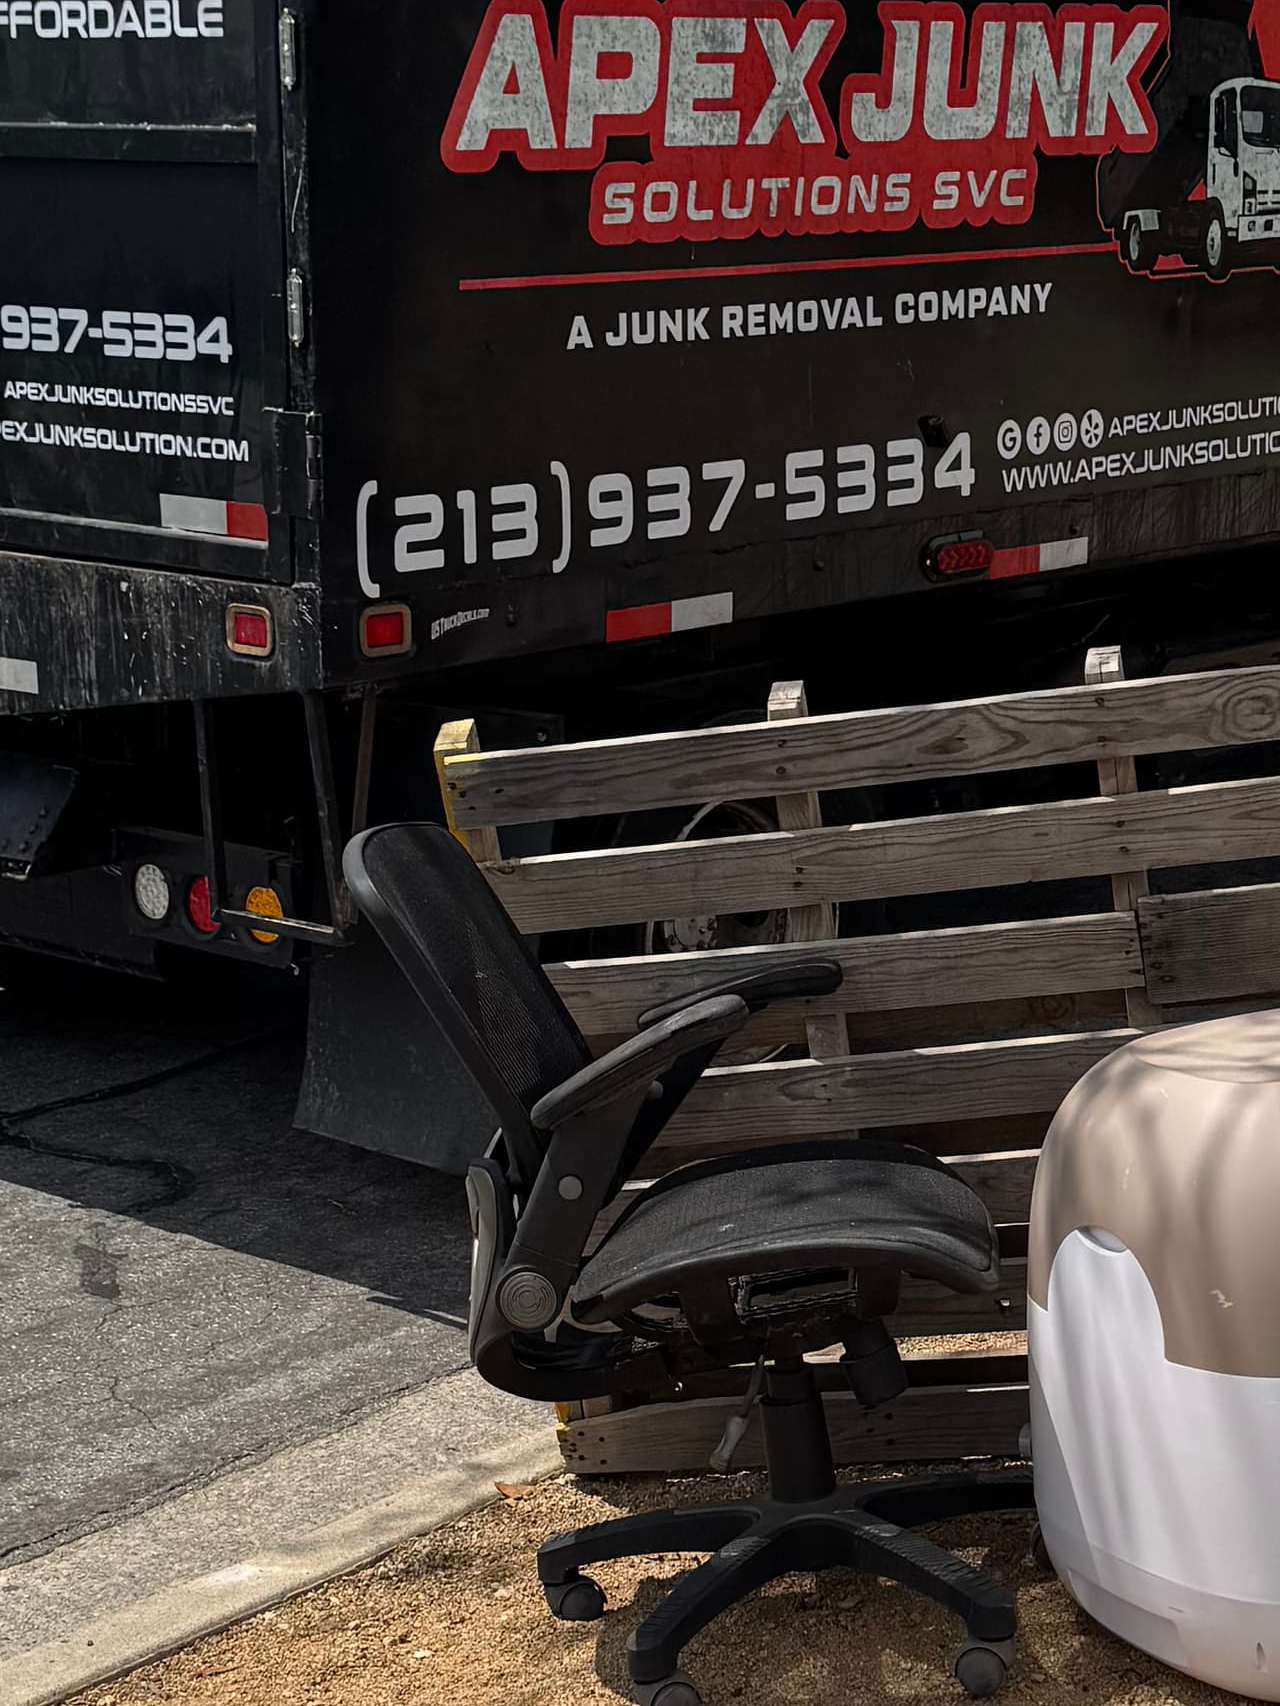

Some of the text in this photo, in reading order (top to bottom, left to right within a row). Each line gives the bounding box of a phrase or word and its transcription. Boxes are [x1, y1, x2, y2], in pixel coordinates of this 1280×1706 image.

[455, 11, 1160, 152] APEX JUNK
[601, 167, 1029, 226] SOLUTIONS SVC
[565, 282, 1053, 351] A JUNK REMOVAL COMPANY
[3, 380, 235, 417] APEXJUNKSOLUTIONSSVC
[355, 431, 977, 599] (213)937-5334
